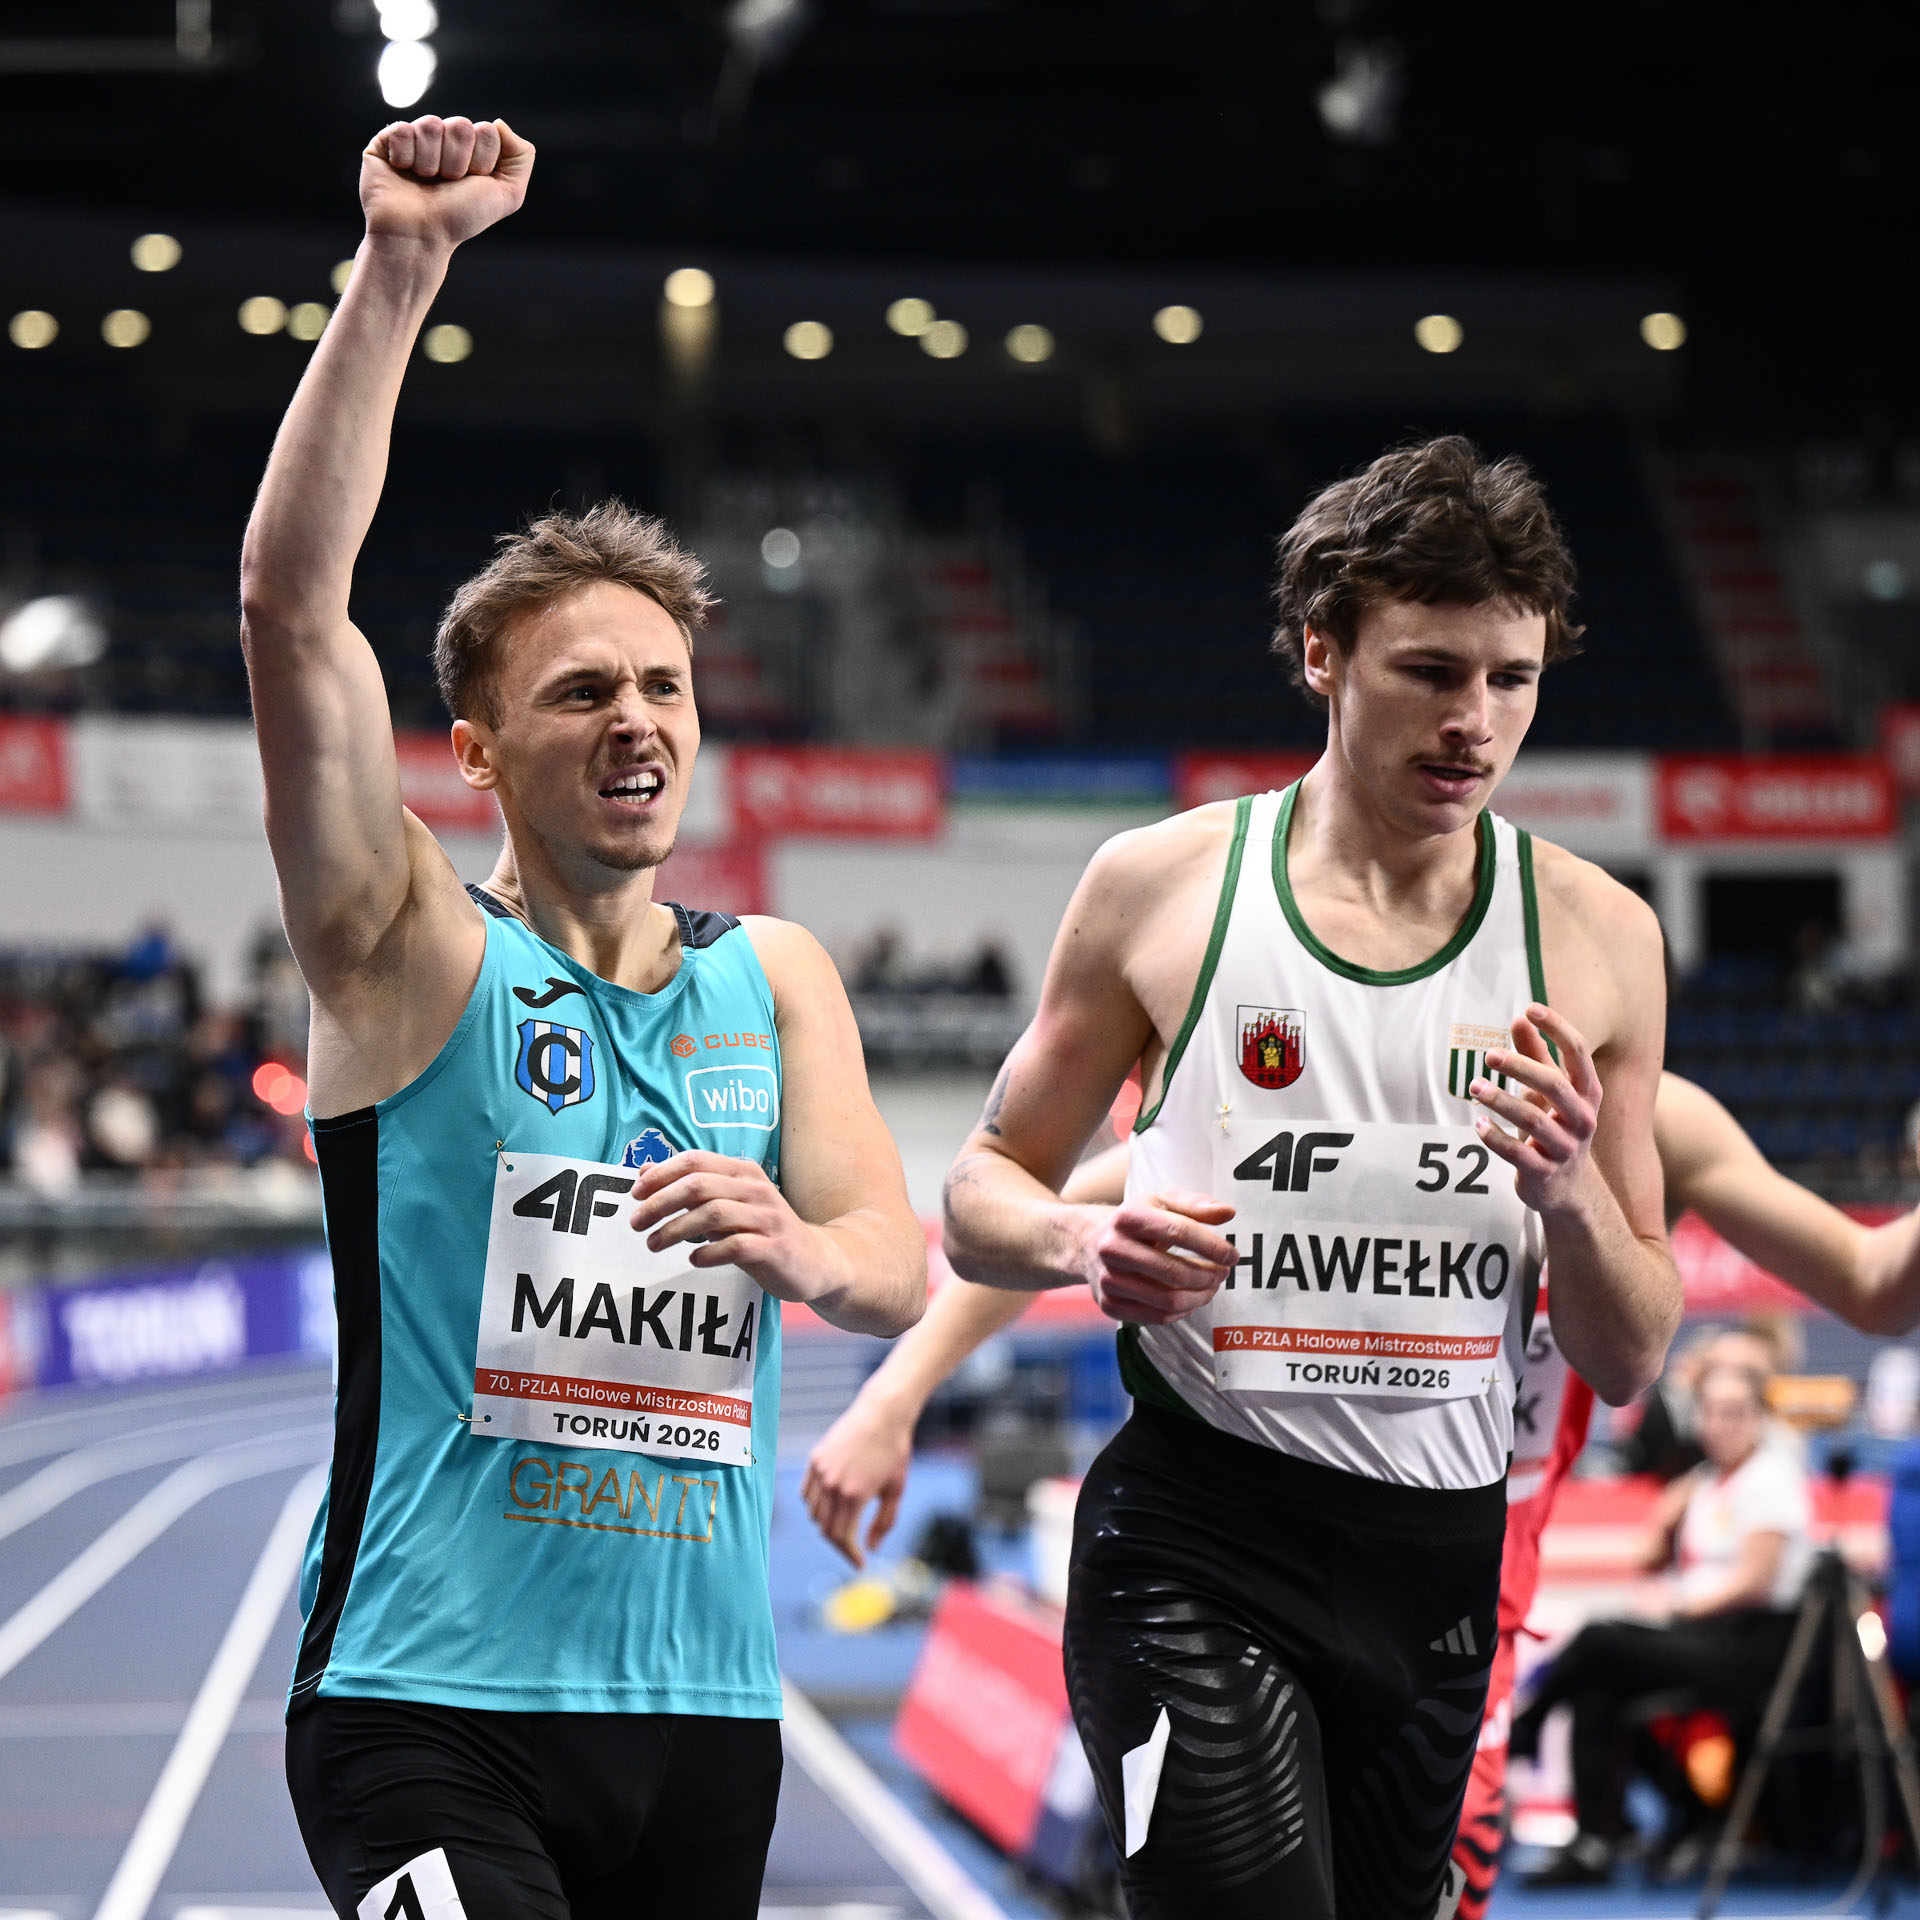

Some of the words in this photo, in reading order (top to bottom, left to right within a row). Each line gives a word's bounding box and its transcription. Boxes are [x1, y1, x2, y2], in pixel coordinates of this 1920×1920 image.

[527, 1033, 582, 1096] C
[704, 1033, 771, 1051] CUBE
[702, 1080, 769, 1113] wibo
[1233, 1131, 1354, 1192] 4F
[1415, 1143, 1490, 1194] 52
[513, 1169, 637, 1236] 4F
[1225, 1233, 1509, 1301] HAWEŁKO
[511, 1273, 756, 1362] MAKIŁA
[1224, 1331, 1248, 1346] 70.
[1252, 1331, 1292, 1347] PZLA
[1296, 1334, 1361, 1351] Halowe
[1364, 1336, 1463, 1355] Mistrzostwa
[1464, 1340, 1495, 1356] Polski
[488, 1374, 515, 1393] 70.
[519, 1378, 560, 1397] PZLA
[566, 1383, 631, 1404] Halowe
[635, 1391, 732, 1418] Mistrzostwa
[732, 1403, 748, 1421] Polski
[1286, 1360, 1380, 1386] TORUŃ
[1387, 1366, 1450, 1389] 2026
[553, 1412, 651, 1443] TORUŃ
[656, 1424, 720, 1451] 2026
